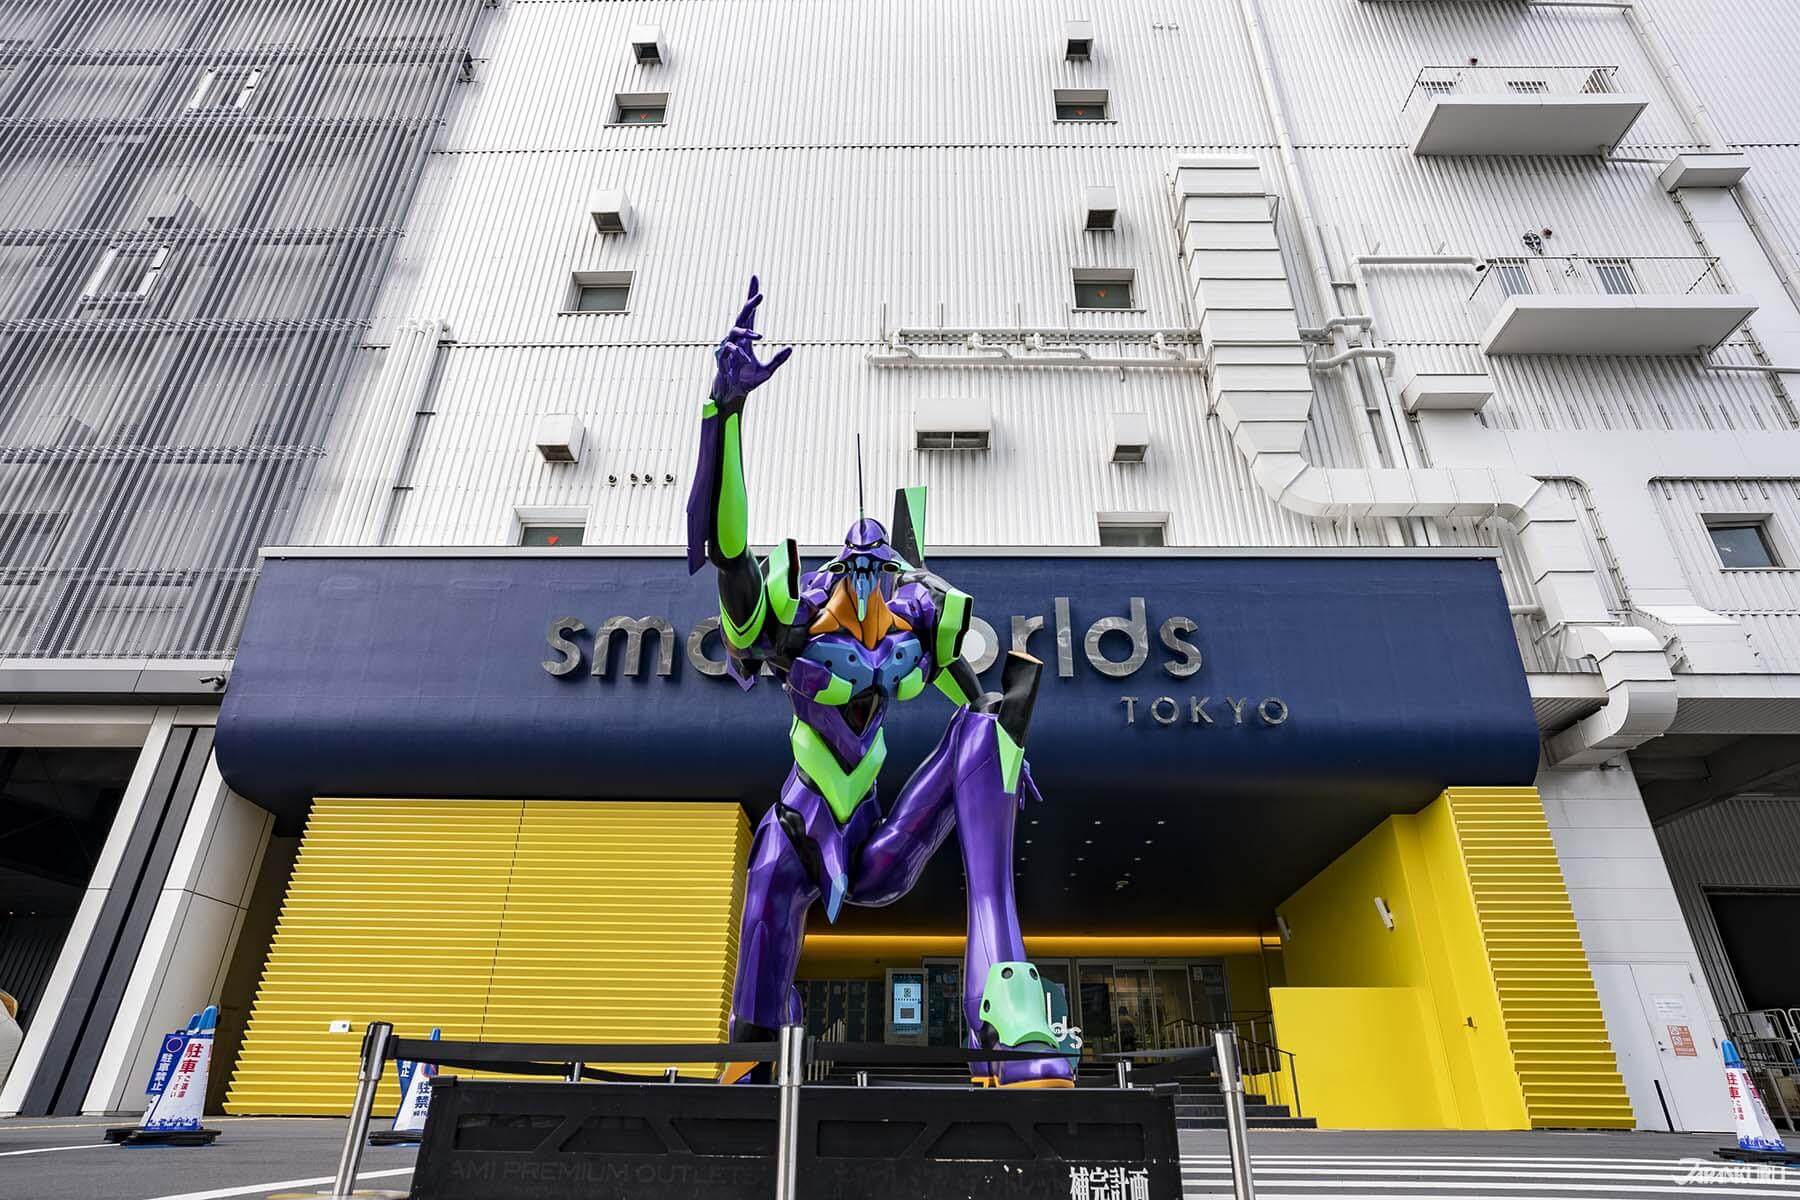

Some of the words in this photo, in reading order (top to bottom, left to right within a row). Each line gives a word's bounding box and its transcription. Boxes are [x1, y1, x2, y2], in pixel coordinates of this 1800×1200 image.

[1120, 695, 1289, 727] TOKYO
[151, 1052, 174, 1092] 駐車禁止
[178, 1043, 204, 1074] 駐車
[503, 1161, 630, 1183] PREMIUM
[1069, 1166, 1150, 1200] 補完計画
